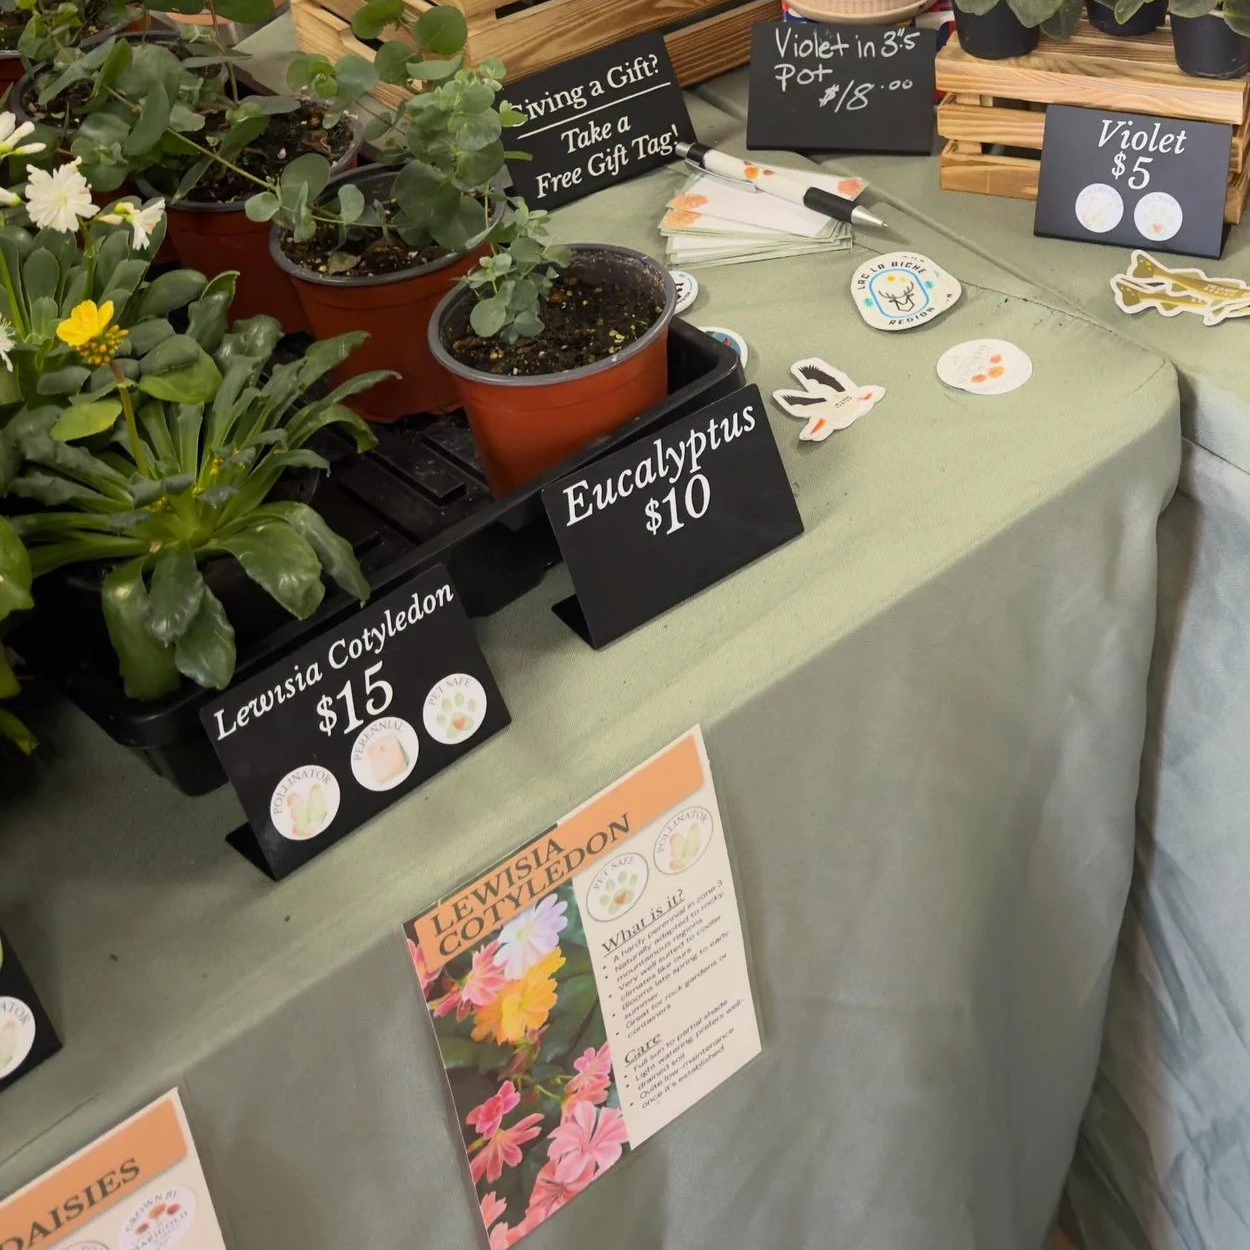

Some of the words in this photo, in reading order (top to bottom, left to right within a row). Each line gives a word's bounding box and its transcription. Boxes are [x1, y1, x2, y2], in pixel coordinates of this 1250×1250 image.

[774, 26, 850, 59] Violet
[855, 31, 877, 57] in
[589, 80, 604, 97] a
[606, 54, 659, 88] Gift?
[774, 62, 832, 93] Pot
[561, 120, 612, 154] Take
[617, 115, 631, 132] a
[1096, 118, 1188, 156] Violet
[536, 167, 582, 199] Free
[587, 143, 629, 177] Gift
[631, 124, 679, 160] Tag!
[1110, 151, 1155, 192] $5
[857, 273, 870, 290] LAC
[870, 264, 885, 273] LA
[891, 261, 927, 274] BICHE
[888, 306, 934, 325] REGION
[560, 399, 758, 529] Eucalyptus
[643, 472, 713, 537] $10
[212, 660, 323, 742] Lewisia
[327, 581, 456, 674] Cotyledon
[315, 659, 395, 738] $15
[353, 719, 406, 762] PERENNIAL
[273, 768, 332, 815] POLLINATOR
[430, 837, 566, 938] LEWISIA
[438, 812, 630, 957] COTYLEDON
[602, 918, 648, 953] What
[651, 907, 663, 920] is
[667, 888, 684, 909] it?
[647, 906, 687, 939] perennial
[614, 942, 652, 973] Naturally
[654, 917, 690, 945] adapted
[616, 940, 673, 982] mountainous
[673, 918, 704, 942] regions
[658, 940, 686, 963] suited
[621, 974, 657, 1001] climates
[624, 993, 659, 1020] summer
[625, 1008, 650, 1029] Great
[684, 960, 718, 988] gardens
[627, 1004, 672, 1038] containers
[677, 1018, 703, 1041] partial
[696, 1014, 725, 1038] prefers
[624, 1033, 661, 1064] Care
[664, 1028, 734, 1081] low-maintenance
[678, 1045, 725, 1082] established
[638, 1063, 670, 1090] drained
